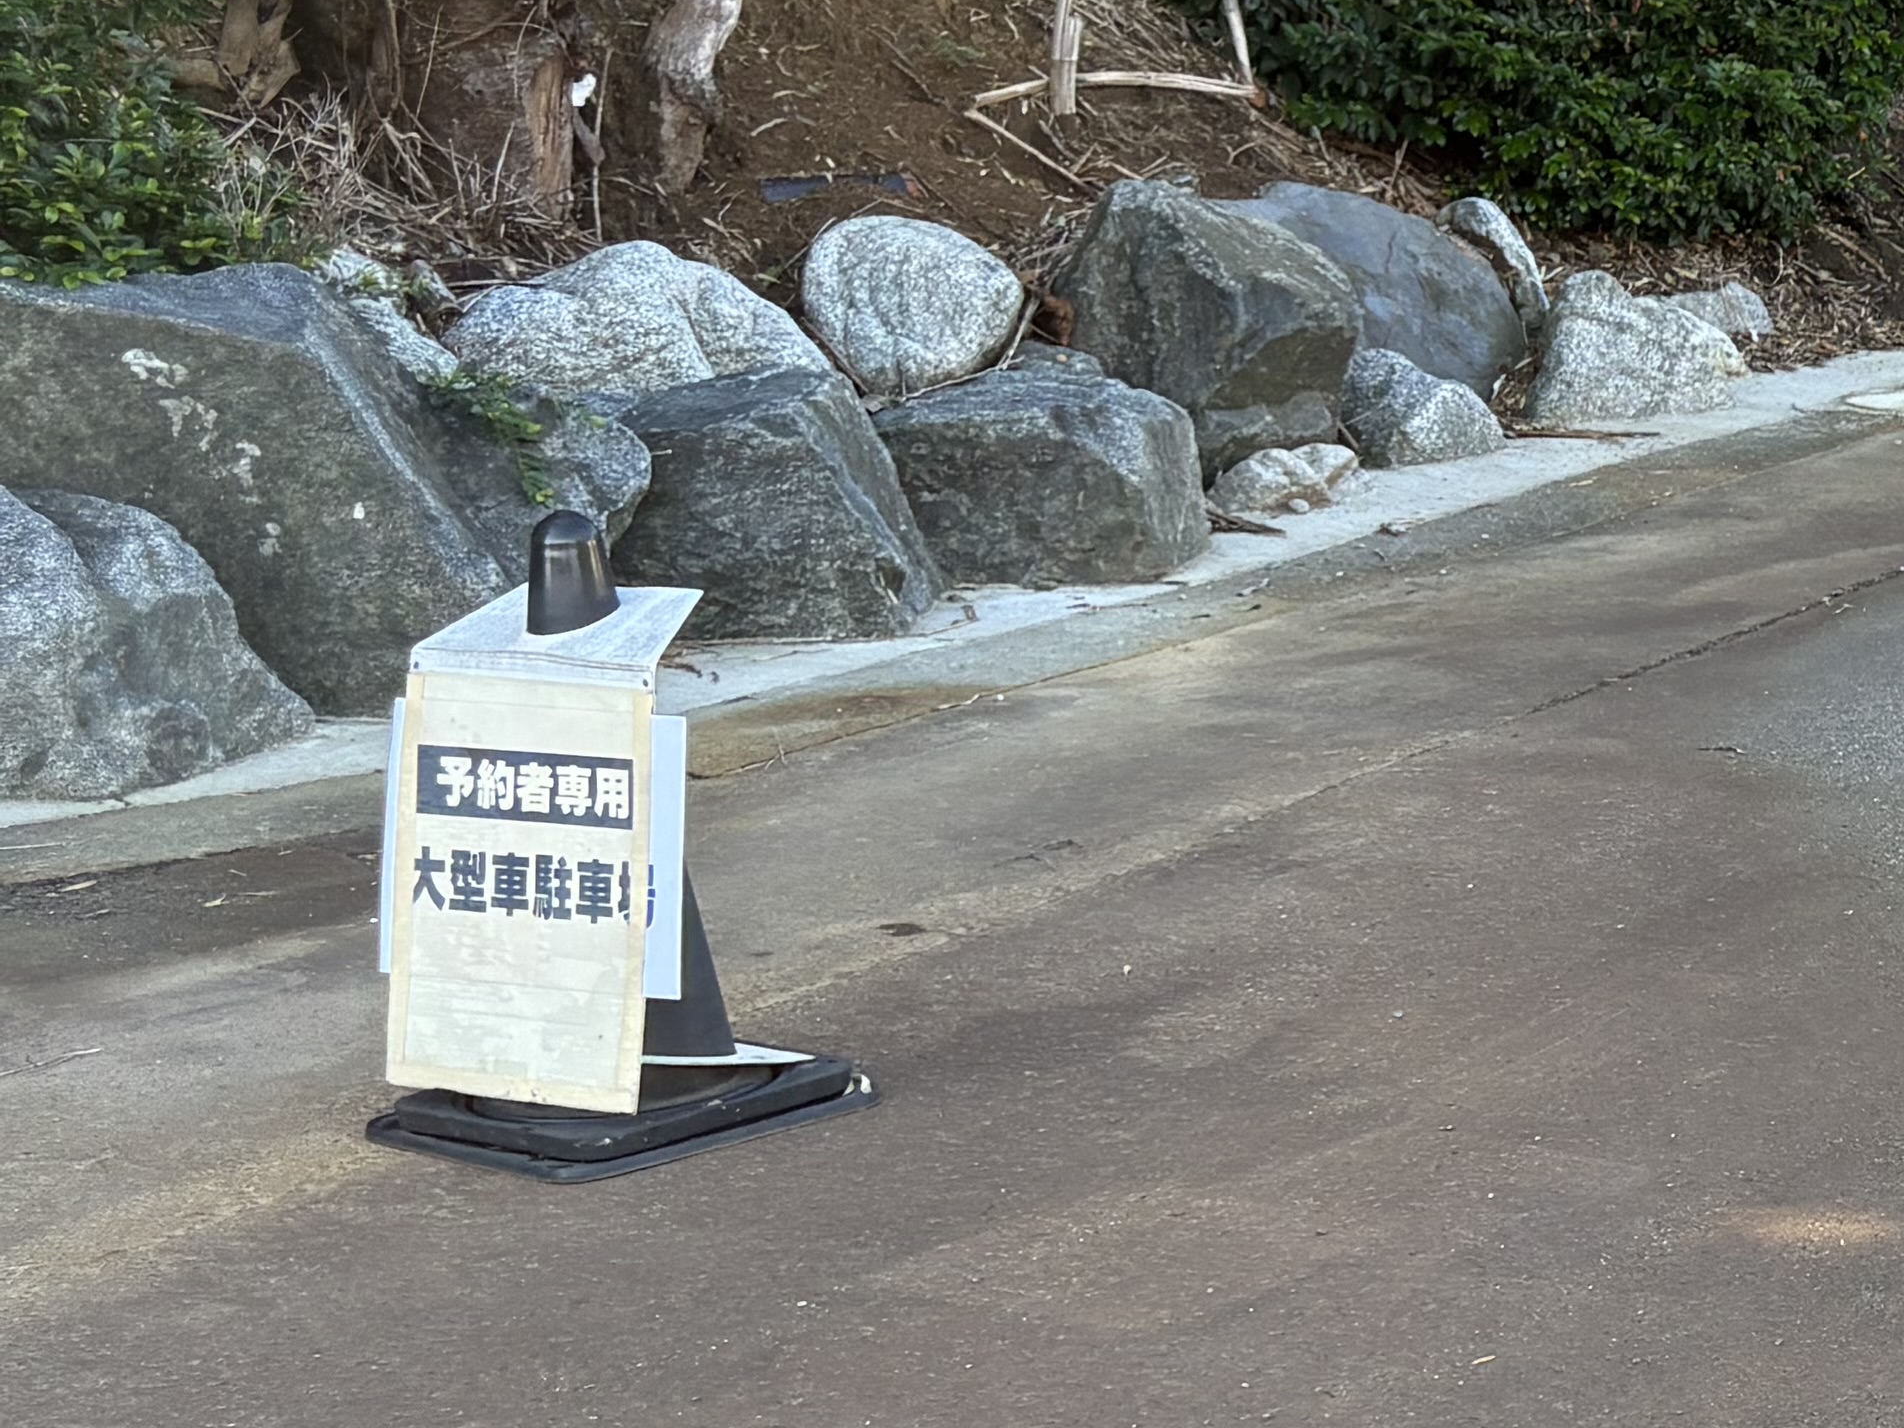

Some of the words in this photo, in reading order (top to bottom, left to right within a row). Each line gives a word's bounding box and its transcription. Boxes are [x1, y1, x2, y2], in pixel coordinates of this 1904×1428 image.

[437, 756, 629, 819] 予約者専用
